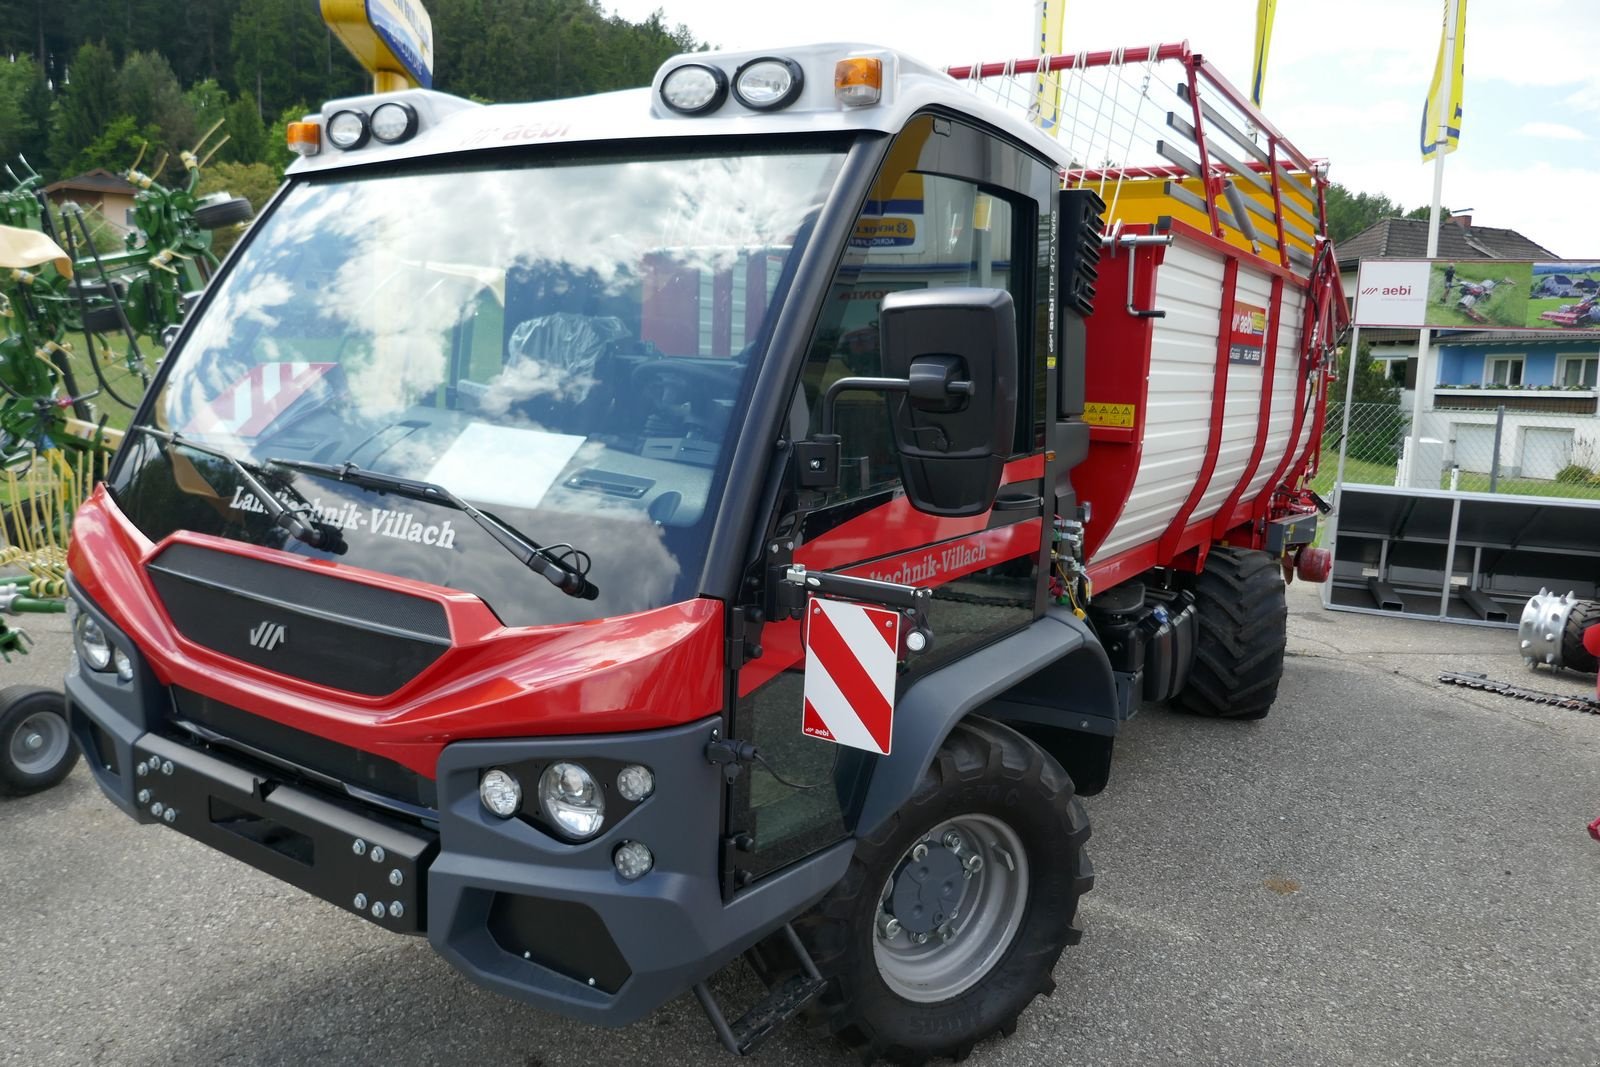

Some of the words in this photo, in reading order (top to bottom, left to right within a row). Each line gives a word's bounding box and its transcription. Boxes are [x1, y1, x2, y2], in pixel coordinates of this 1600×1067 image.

[502, 121, 572, 141] aebi
[1049, 276, 1055, 294] TP
[1382, 285, 1412, 296] aebi
[815, 728, 830, 737] aebi
